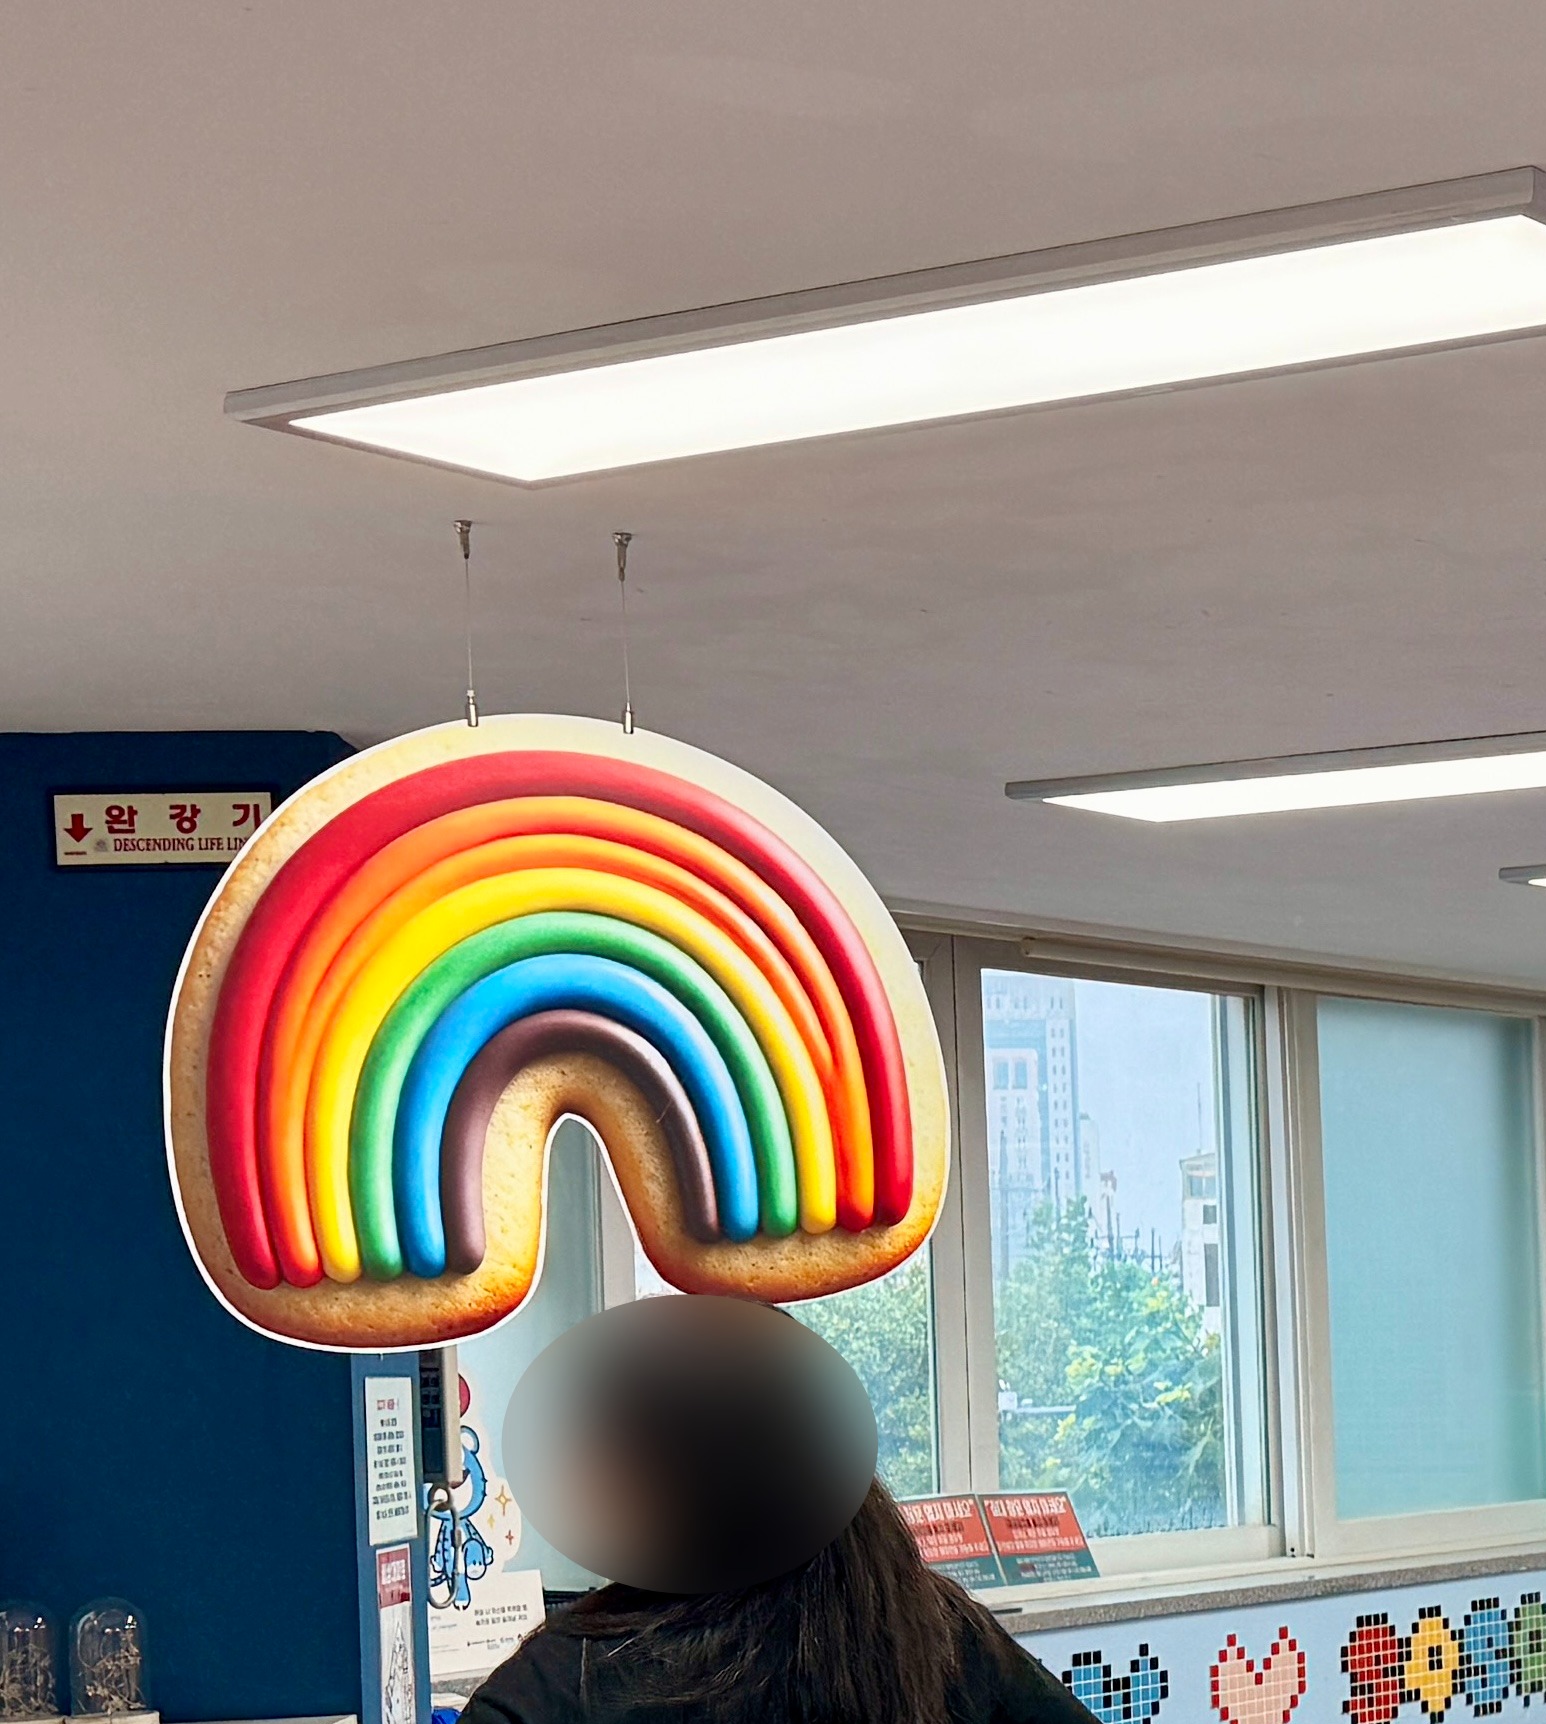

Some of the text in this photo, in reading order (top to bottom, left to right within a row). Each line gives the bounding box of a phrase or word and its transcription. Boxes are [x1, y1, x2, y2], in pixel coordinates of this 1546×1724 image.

[114, 837, 249, 852] DESCENDING LIFE LIN
